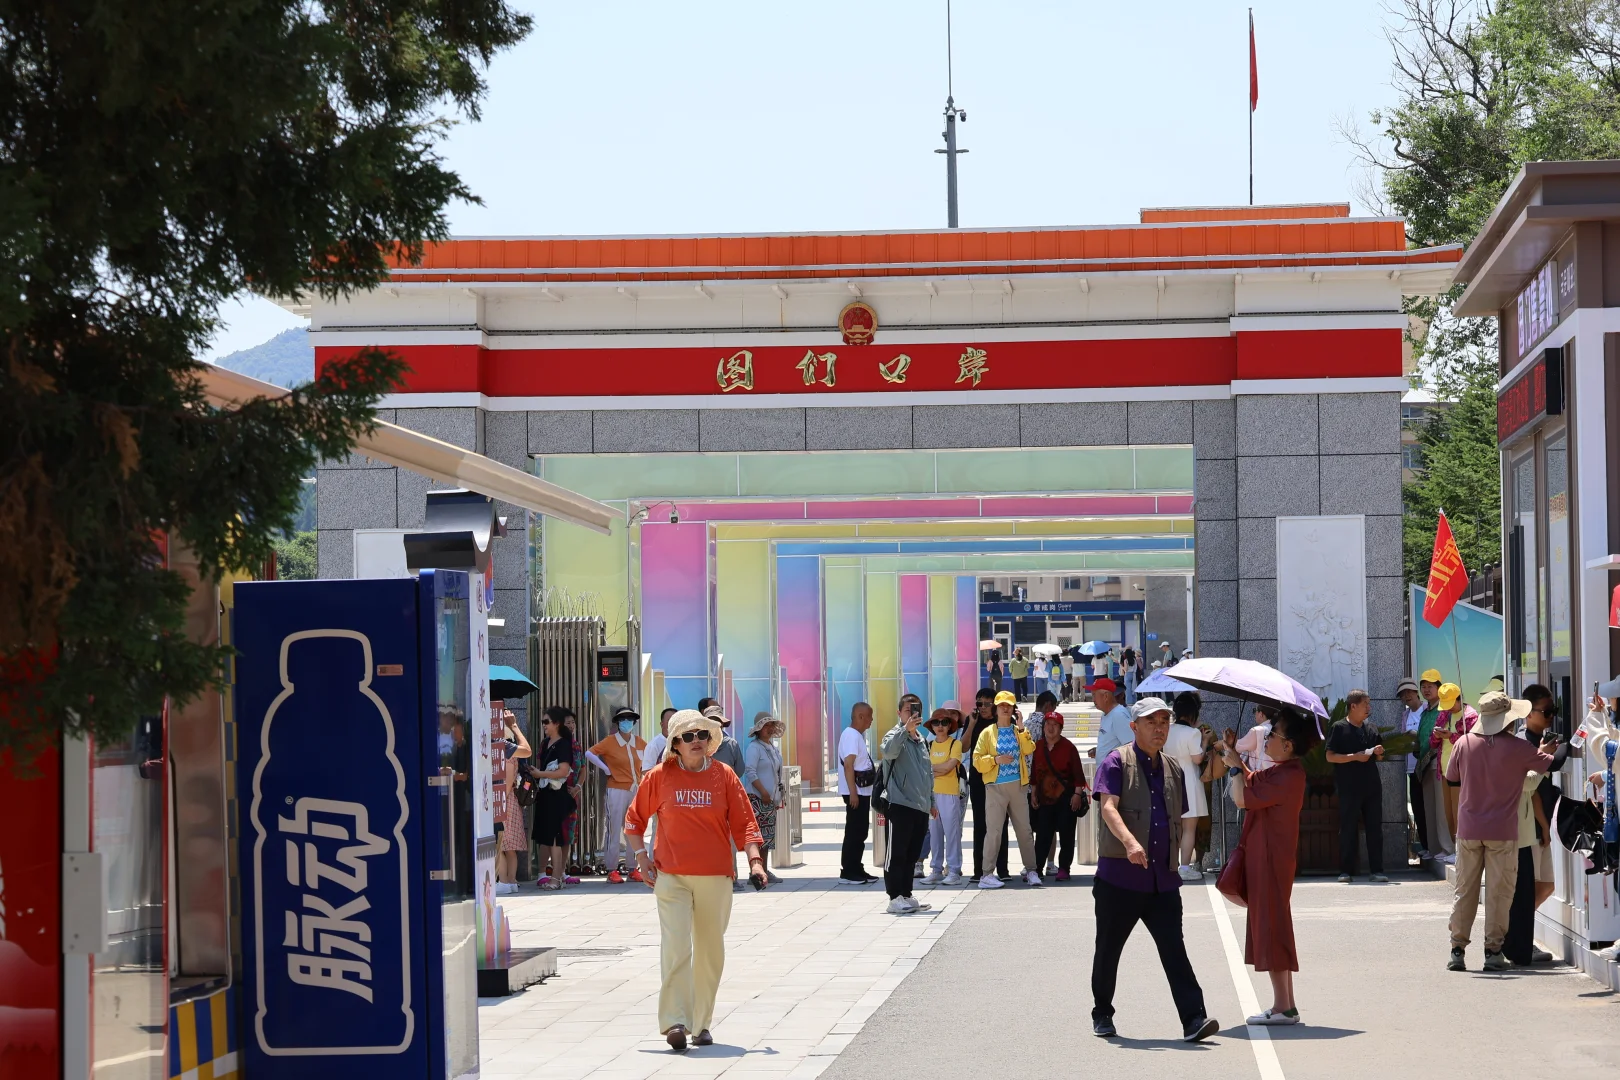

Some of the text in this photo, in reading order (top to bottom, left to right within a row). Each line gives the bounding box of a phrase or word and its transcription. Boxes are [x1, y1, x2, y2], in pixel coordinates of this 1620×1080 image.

[716, 346, 990, 392] 图们口岸
[675, 790, 712, 805] WISHE
[278, 797, 391, 1004] 脉动
